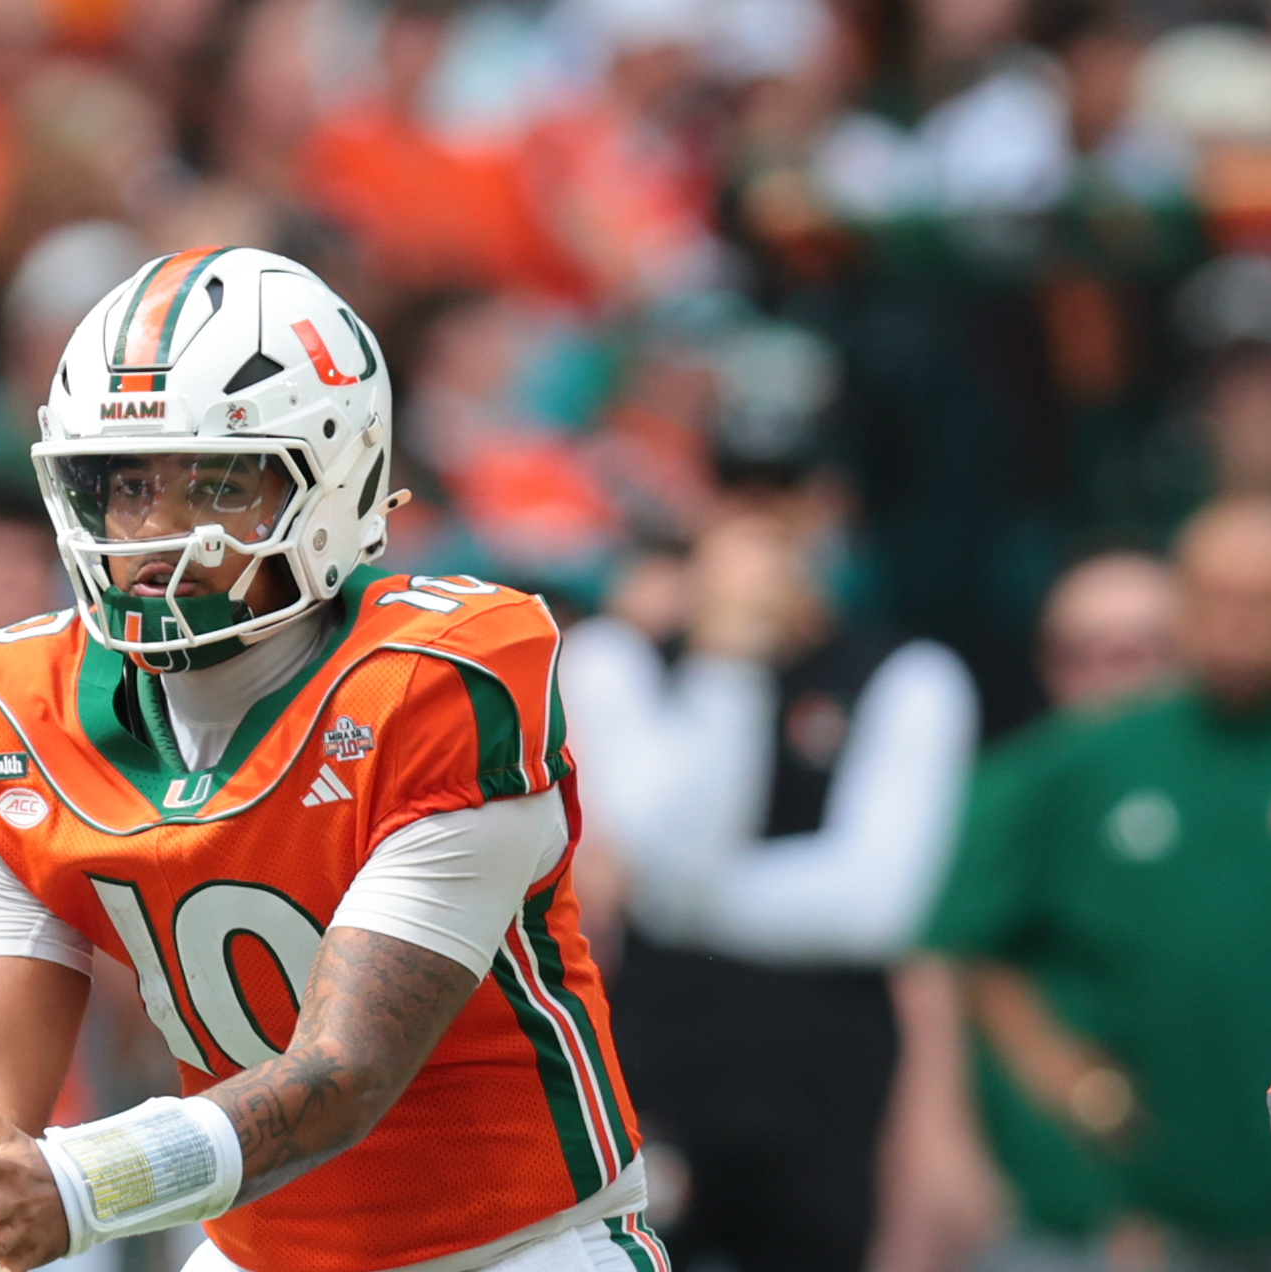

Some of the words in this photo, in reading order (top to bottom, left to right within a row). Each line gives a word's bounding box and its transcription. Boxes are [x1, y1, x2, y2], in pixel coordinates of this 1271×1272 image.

[289, 307, 377, 386] U
[100, 401, 166, 420] MIAMI
[328, 731, 350, 741] MIRA
[338, 739, 359, 758] 10
[162, 774, 213, 808] U
[7, 799, 41, 812] ACC
[84, 871, 326, 1078] 10
